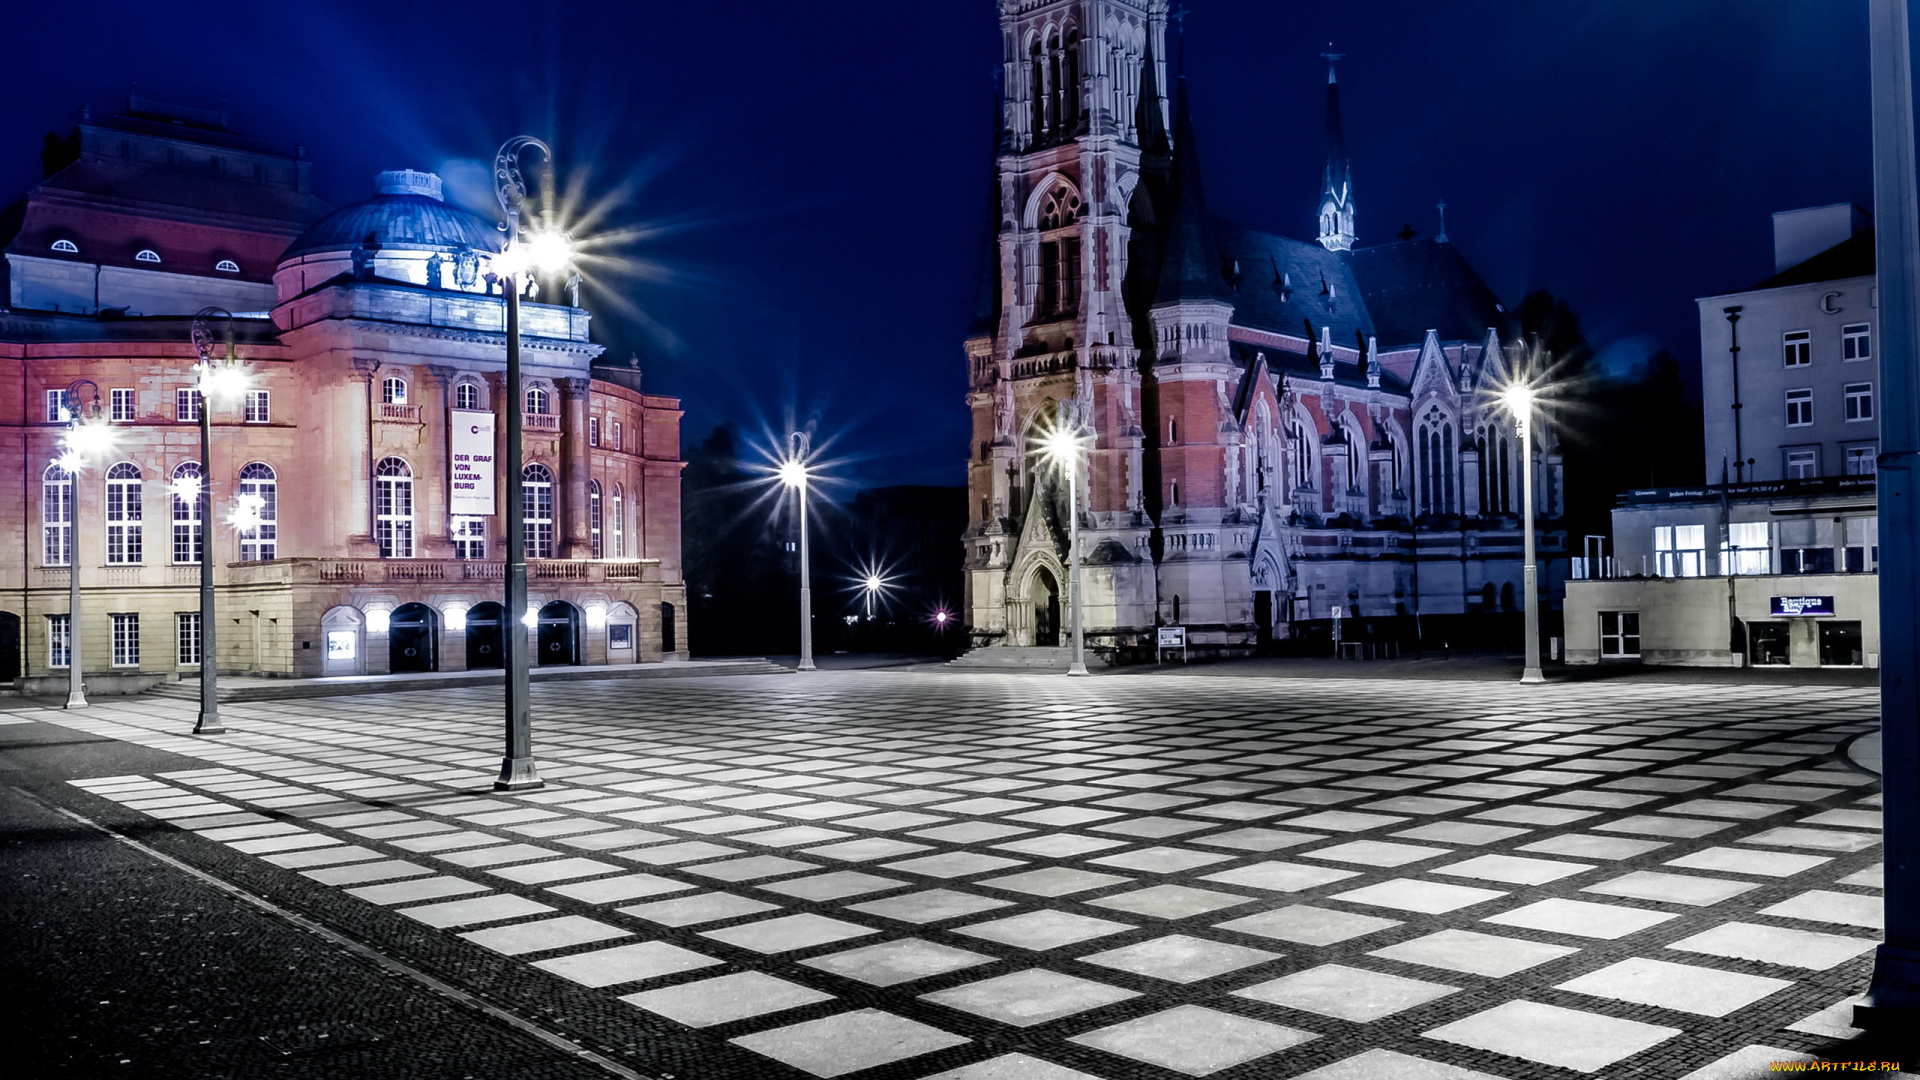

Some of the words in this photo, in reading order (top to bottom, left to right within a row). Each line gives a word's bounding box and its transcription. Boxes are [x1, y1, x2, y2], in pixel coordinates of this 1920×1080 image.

[454, 473, 482, 481] LUXEM-
[454, 482, 475, 490] BURG
[1780, 597, 1822, 608] Boutique
